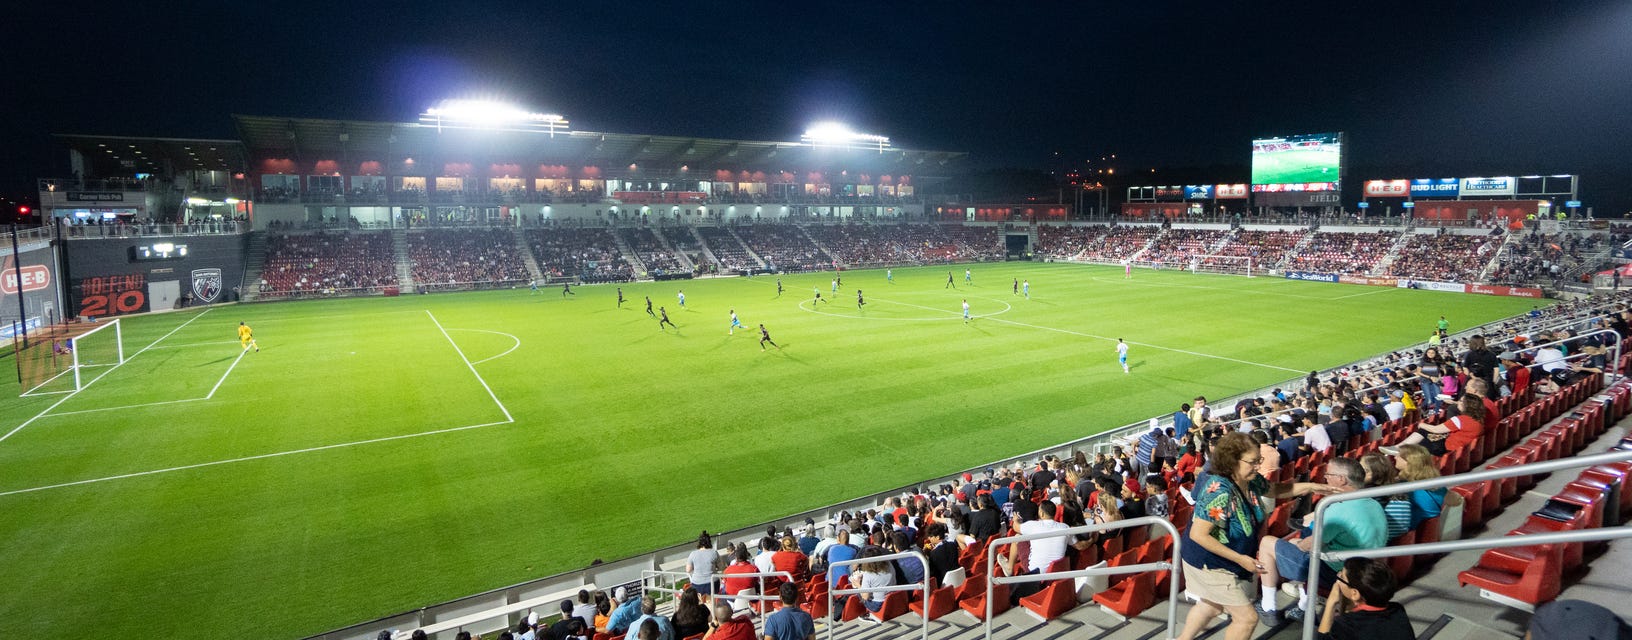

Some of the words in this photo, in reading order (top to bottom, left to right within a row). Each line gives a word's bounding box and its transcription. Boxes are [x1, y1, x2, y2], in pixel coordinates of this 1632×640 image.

[82, 273, 144, 295] #DEFEND
[1302, 273, 1334, 282] SeaWorld
[80, 290, 145, 316] 210
